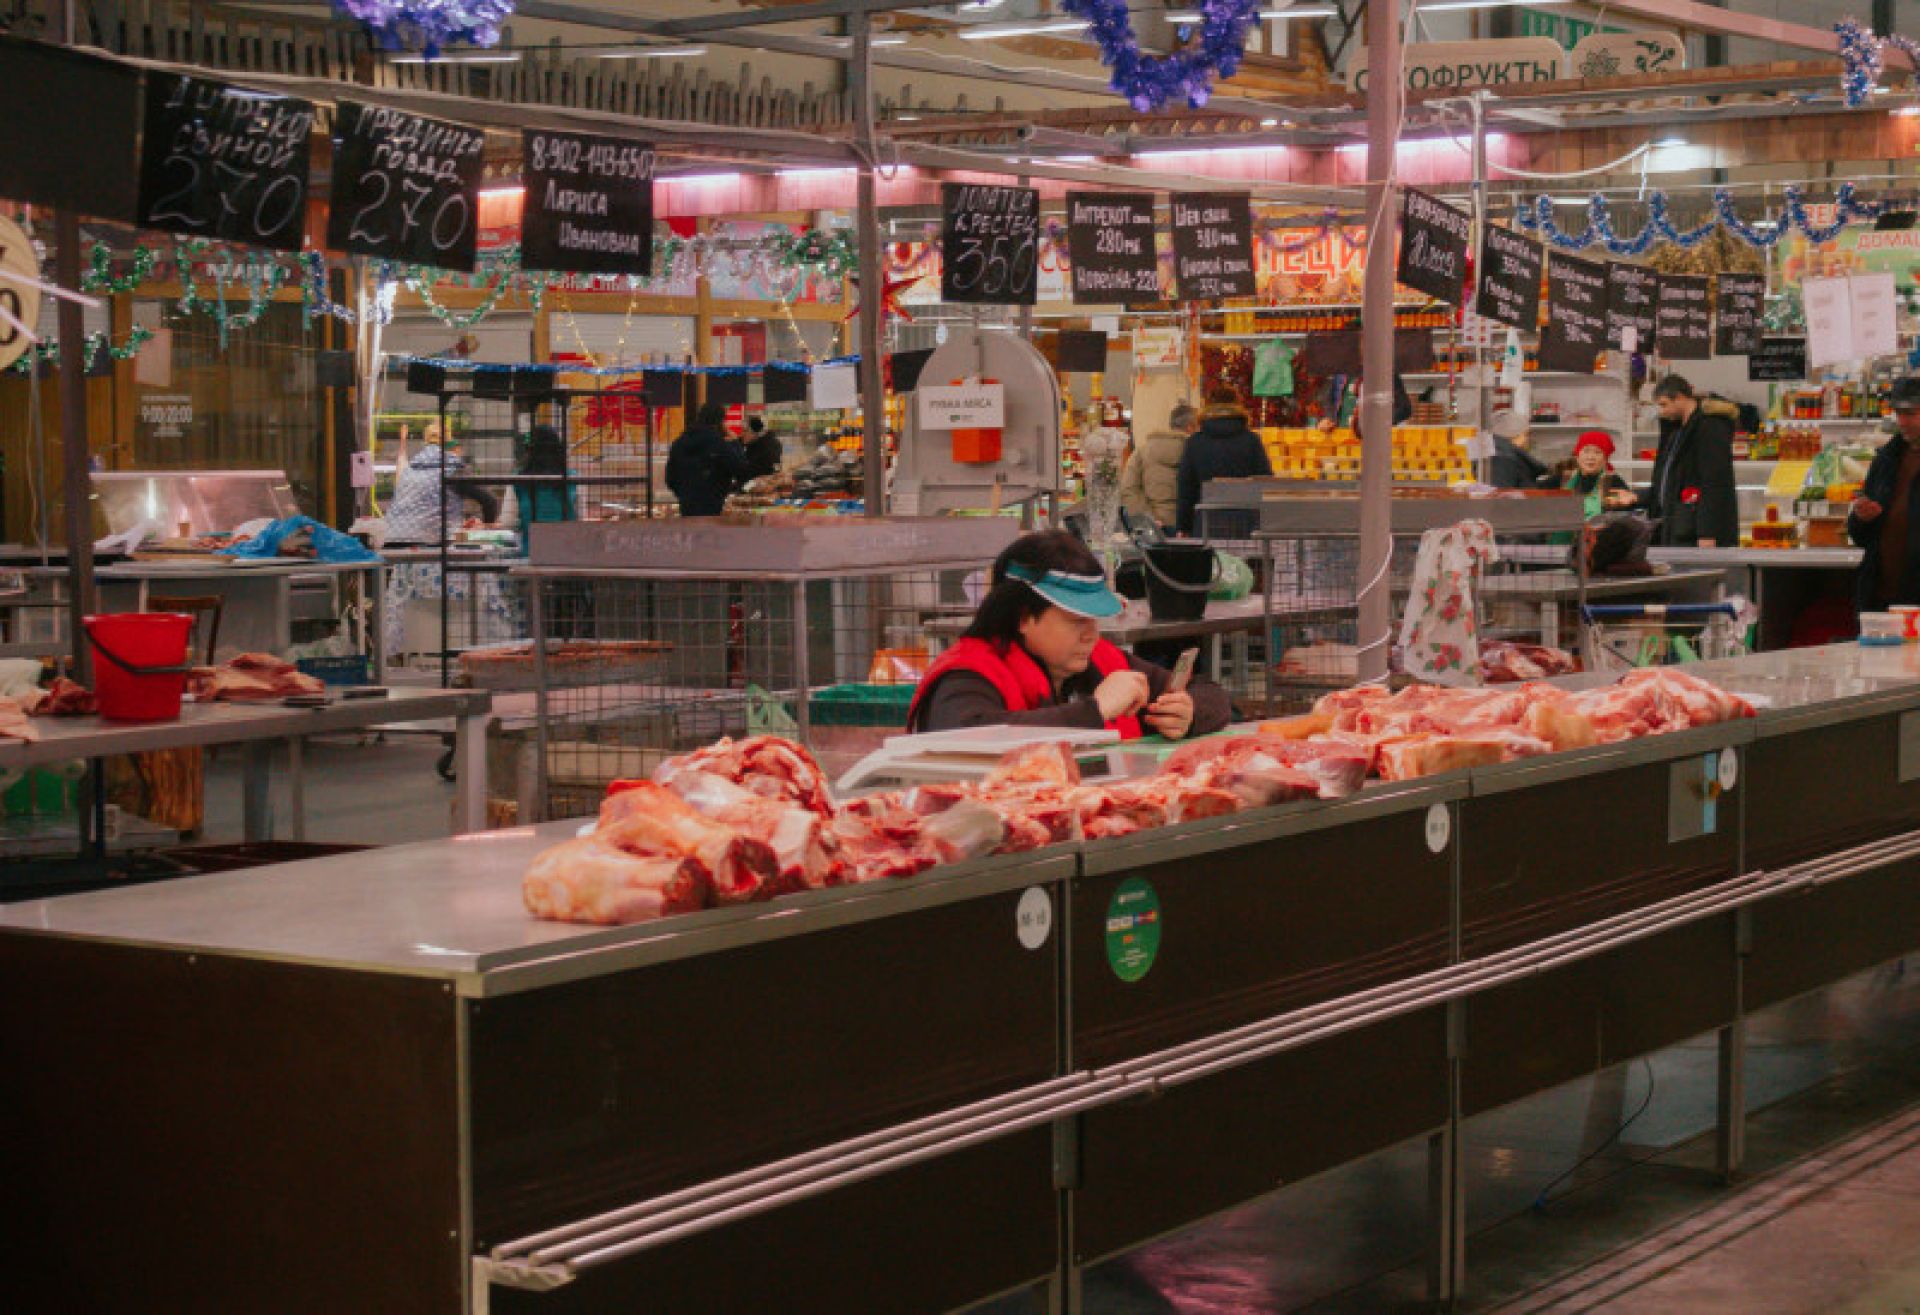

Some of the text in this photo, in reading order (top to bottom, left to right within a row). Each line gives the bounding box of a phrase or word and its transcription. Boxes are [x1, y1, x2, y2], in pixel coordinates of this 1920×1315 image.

[1354, 60, 1556, 92] СОФРУКТЫ
[148, 155, 301, 236] 270
[348, 170, 468, 250] 270
[953, 236, 1035, 294] 350
[1096, 228, 1123, 252] 280
